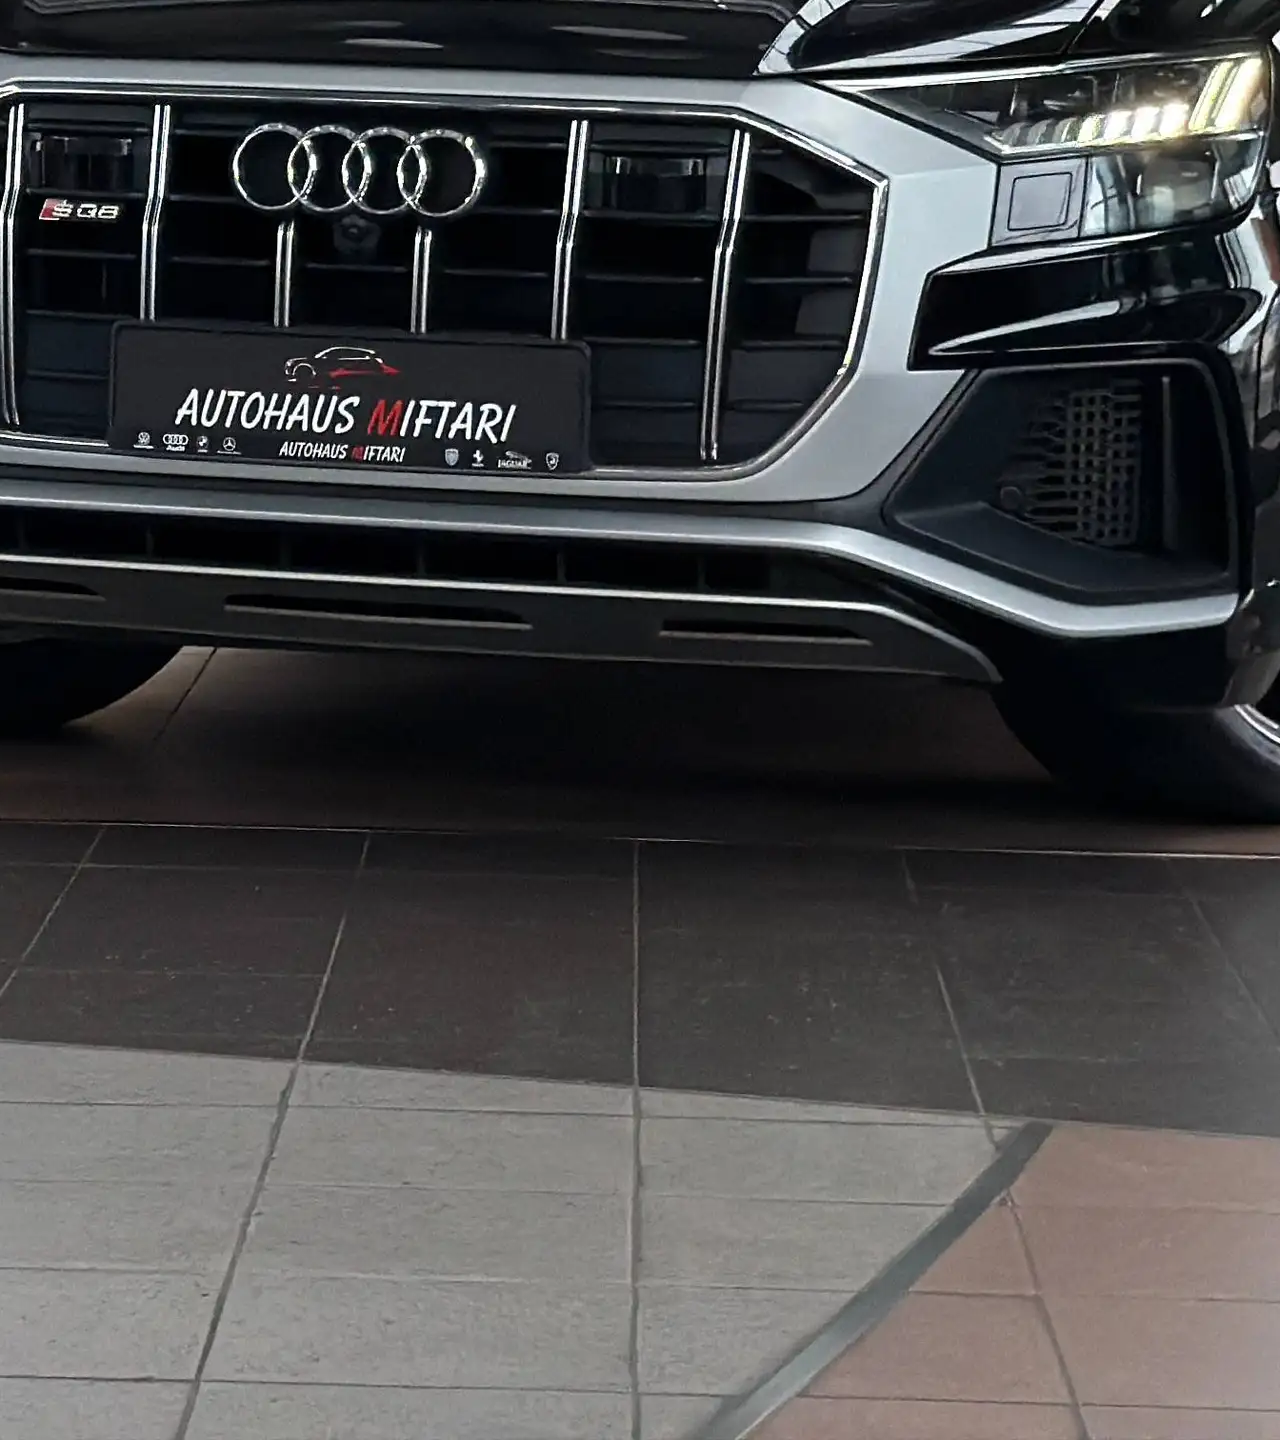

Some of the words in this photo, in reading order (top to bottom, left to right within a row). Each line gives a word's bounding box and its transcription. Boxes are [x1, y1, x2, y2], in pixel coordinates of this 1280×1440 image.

[174, 387, 360, 434] AUTOHAUS
[367, 398, 517, 444] MIFTARI
[279, 441, 349, 459] AUTOHAUS
